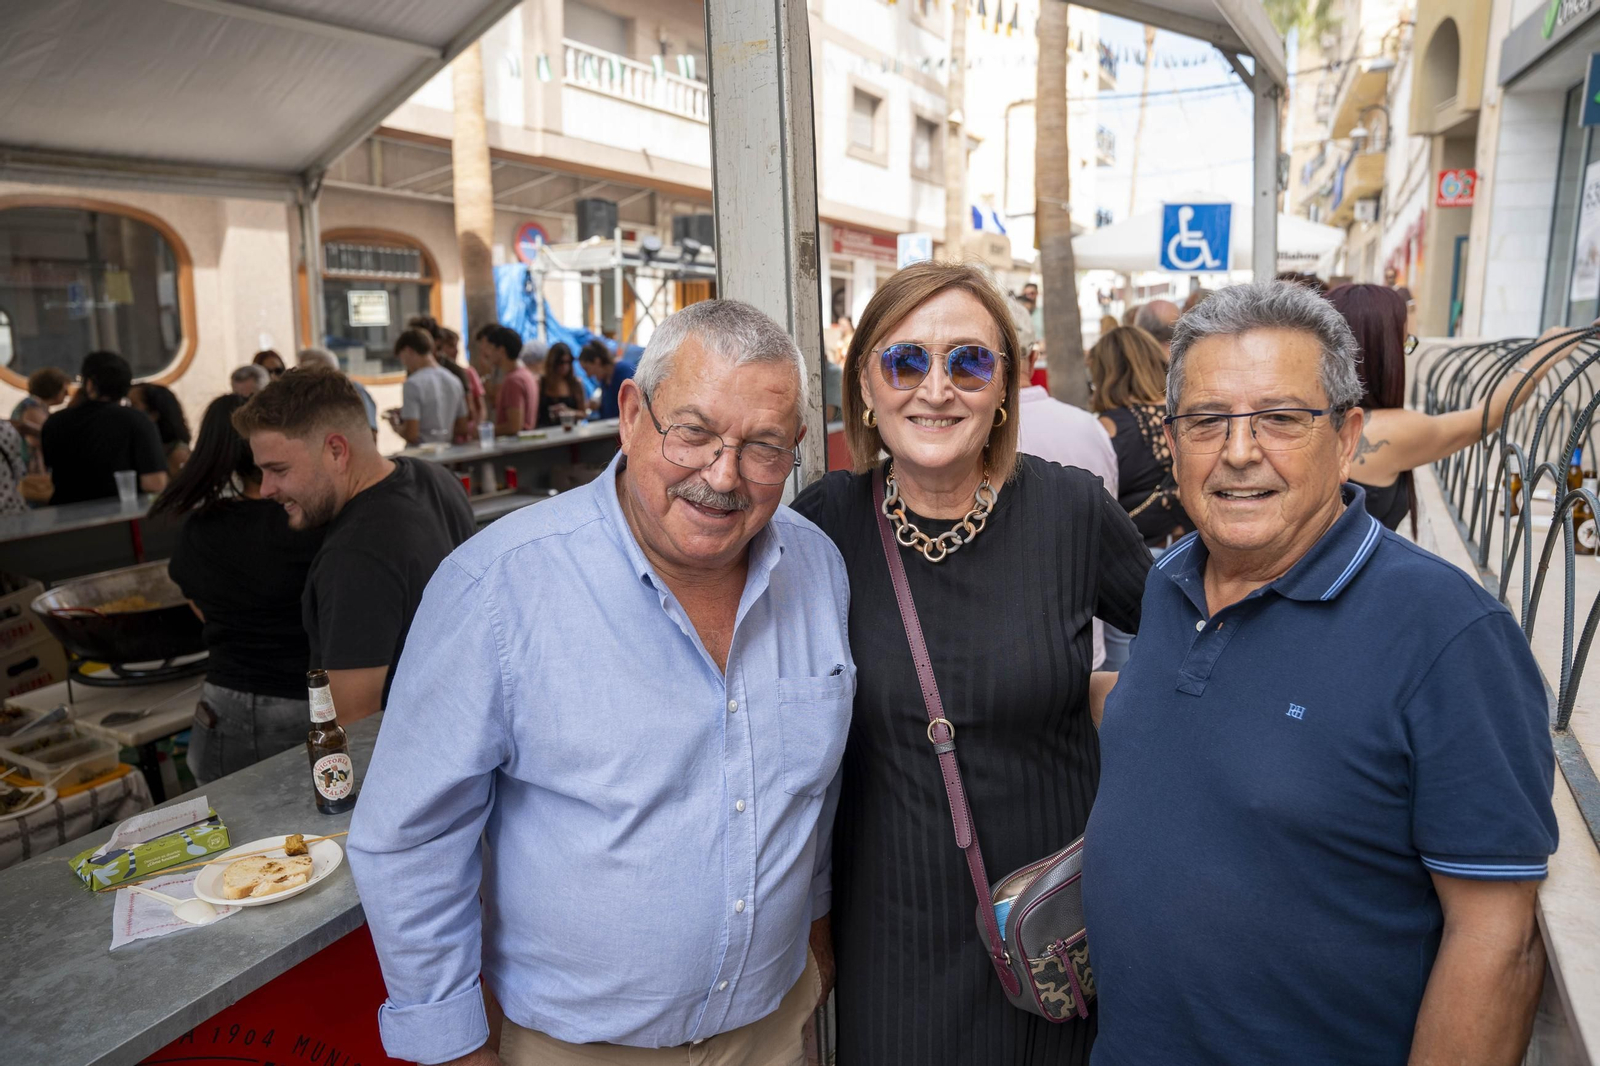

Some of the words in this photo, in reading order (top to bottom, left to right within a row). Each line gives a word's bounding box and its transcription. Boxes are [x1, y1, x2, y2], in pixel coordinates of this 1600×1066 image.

[315, 757, 348, 772] VICTORIA
[212, 1023, 276, 1048] 1904
[292, 1034, 362, 1066] MUNI
